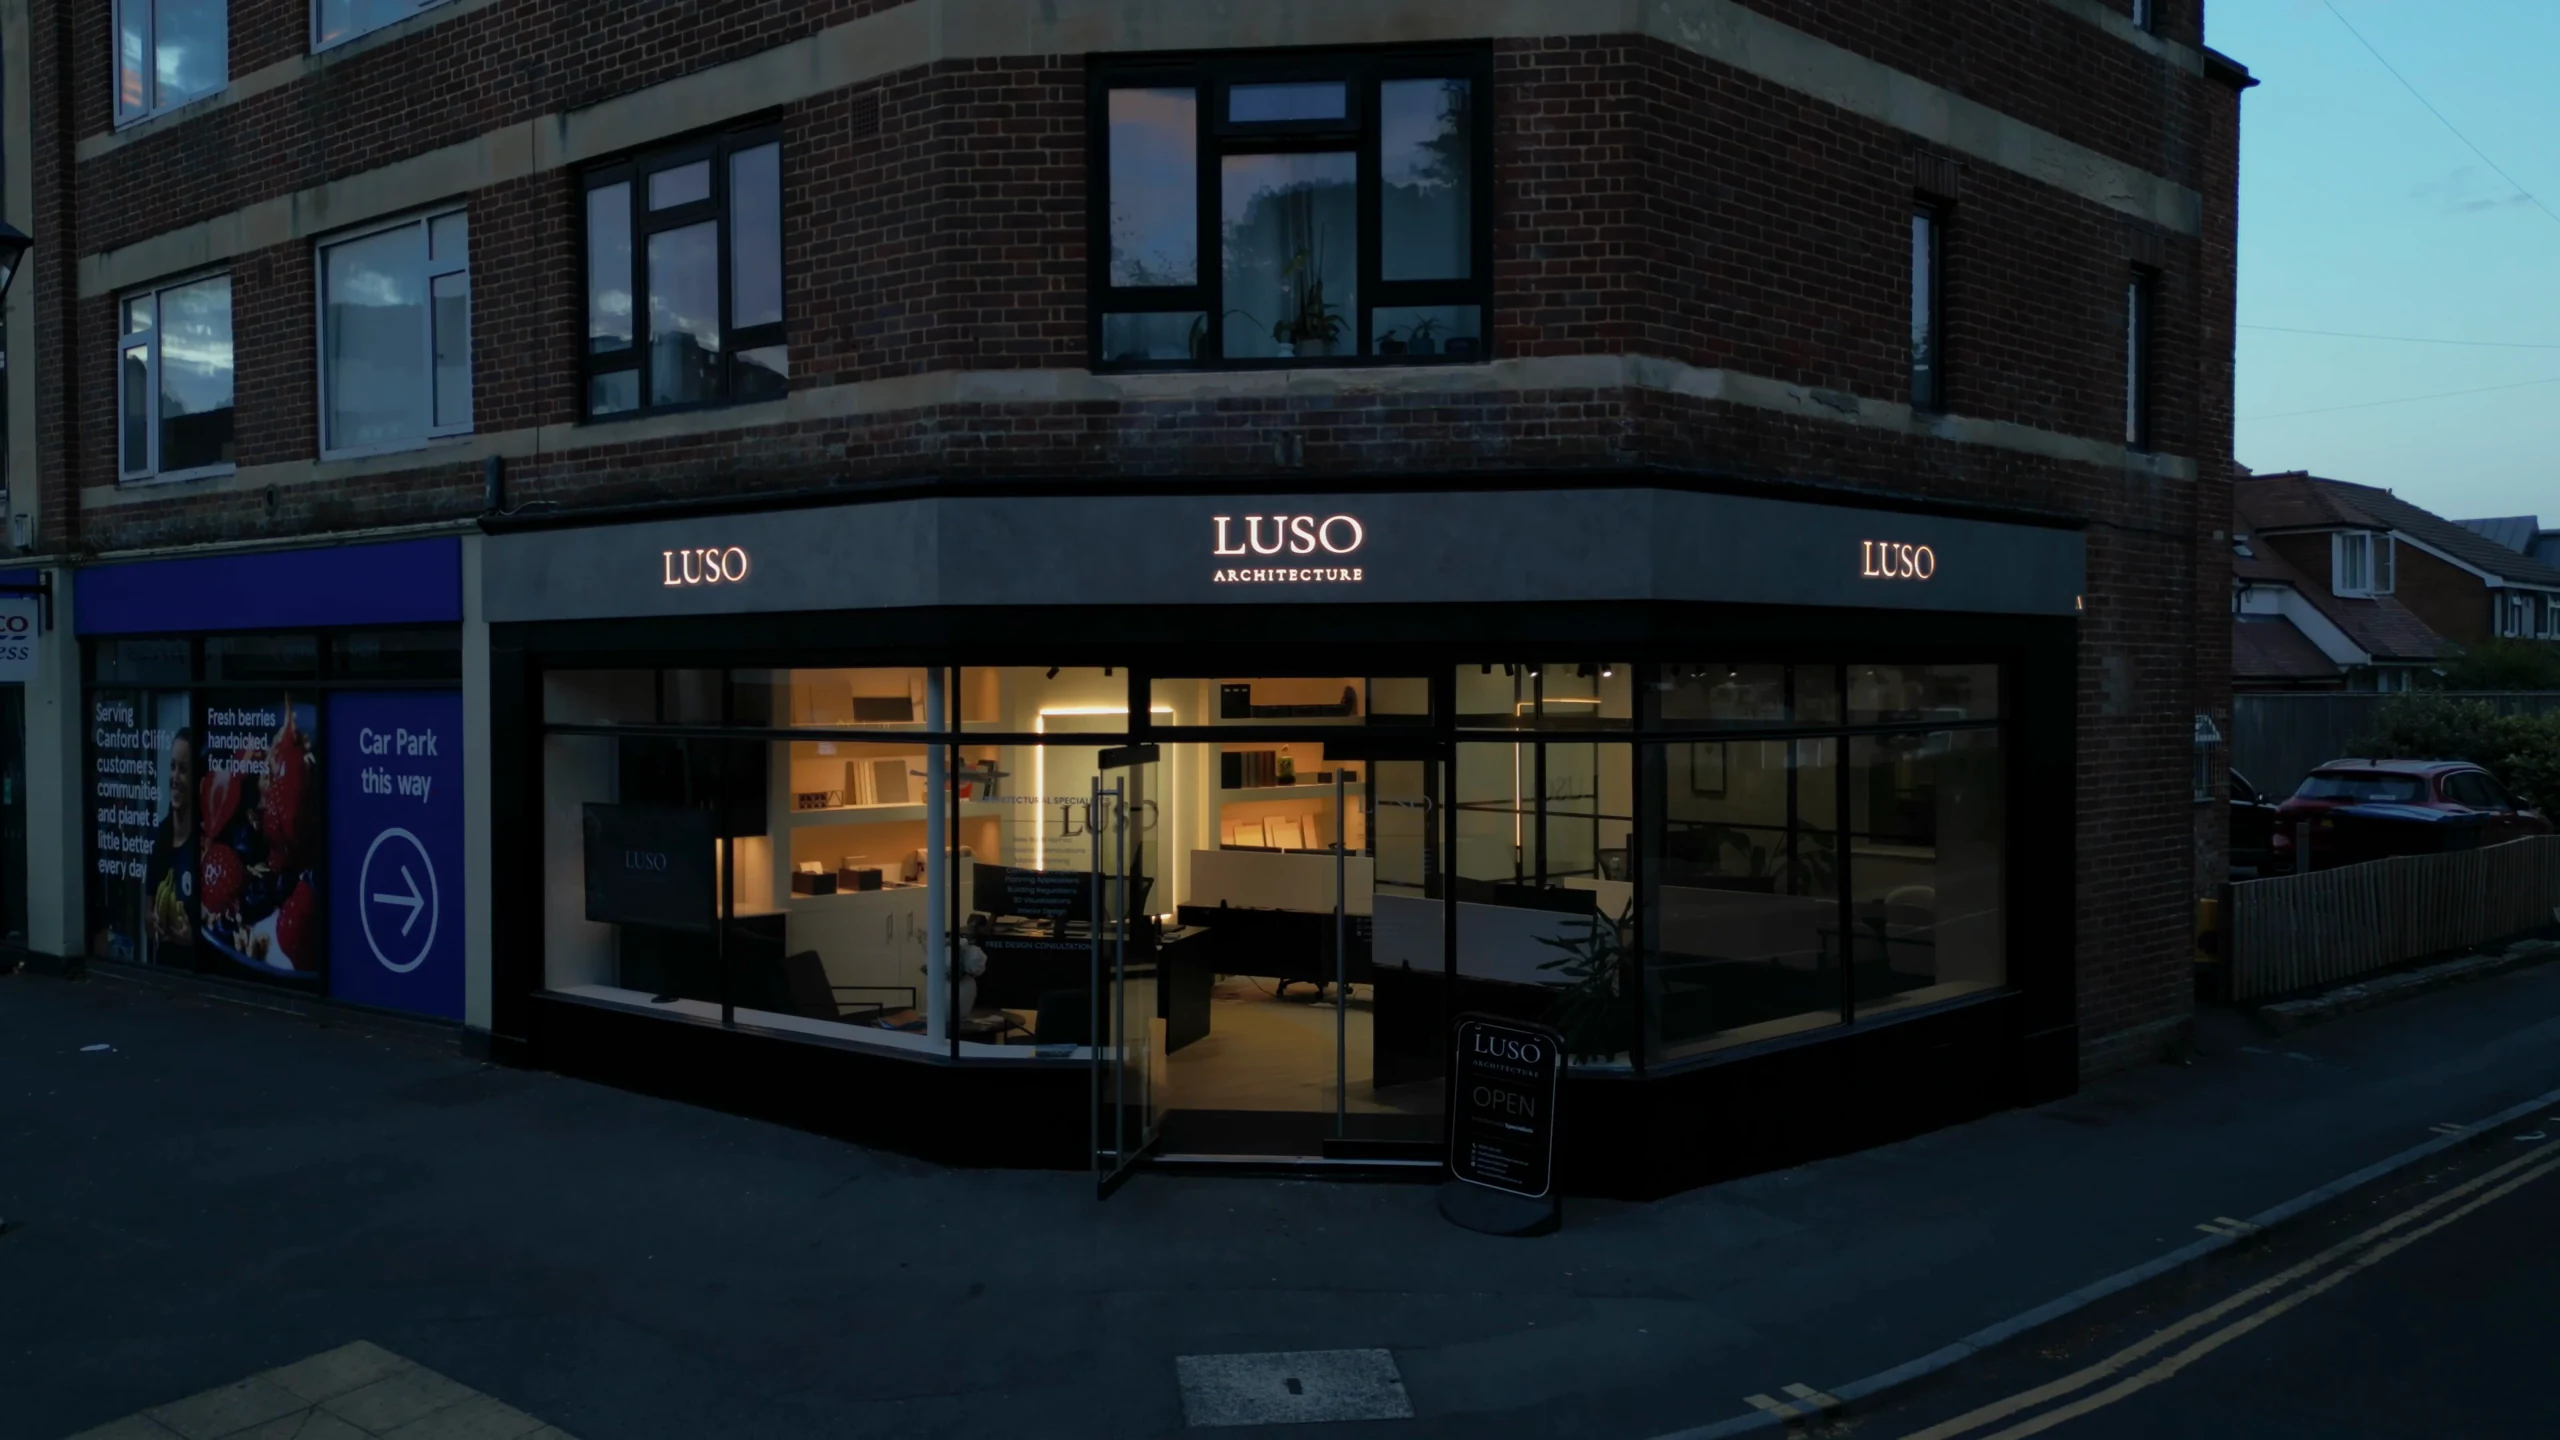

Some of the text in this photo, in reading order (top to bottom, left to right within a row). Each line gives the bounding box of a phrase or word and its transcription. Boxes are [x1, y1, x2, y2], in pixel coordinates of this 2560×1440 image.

[1213, 515, 1363, 555] LUSO
[663, 546, 748, 585] LUSO
[1863, 541, 1936, 579] LUSO
[1213, 568, 1363, 582] ARCHITECTURE
[95, 703, 134, 728] Serving
[207, 707, 276, 728] Fresh berries
[96, 728, 139, 749] Canford
[208, 731, 268, 752] handpicked
[359, 727, 438, 757] Car Park
[96, 756, 157, 778] customers,
[208, 753, 270, 778] for ripeness
[97, 780, 161, 802] communities
[361, 766, 432, 804] this way
[97, 804, 160, 829] and planet a
[97, 829, 156, 855] little better
[97, 857, 147, 883] every day
[625, 850, 667, 872] LUSO
[985, 941, 1003, 949] FREE
[1005, 941, 1033, 950] DESIGN
[1473, 1033, 1541, 1064] LUSO
[1471, 1059, 1540, 1079] ARCHITECTURE
[1473, 1085, 1536, 1118] OPEN
